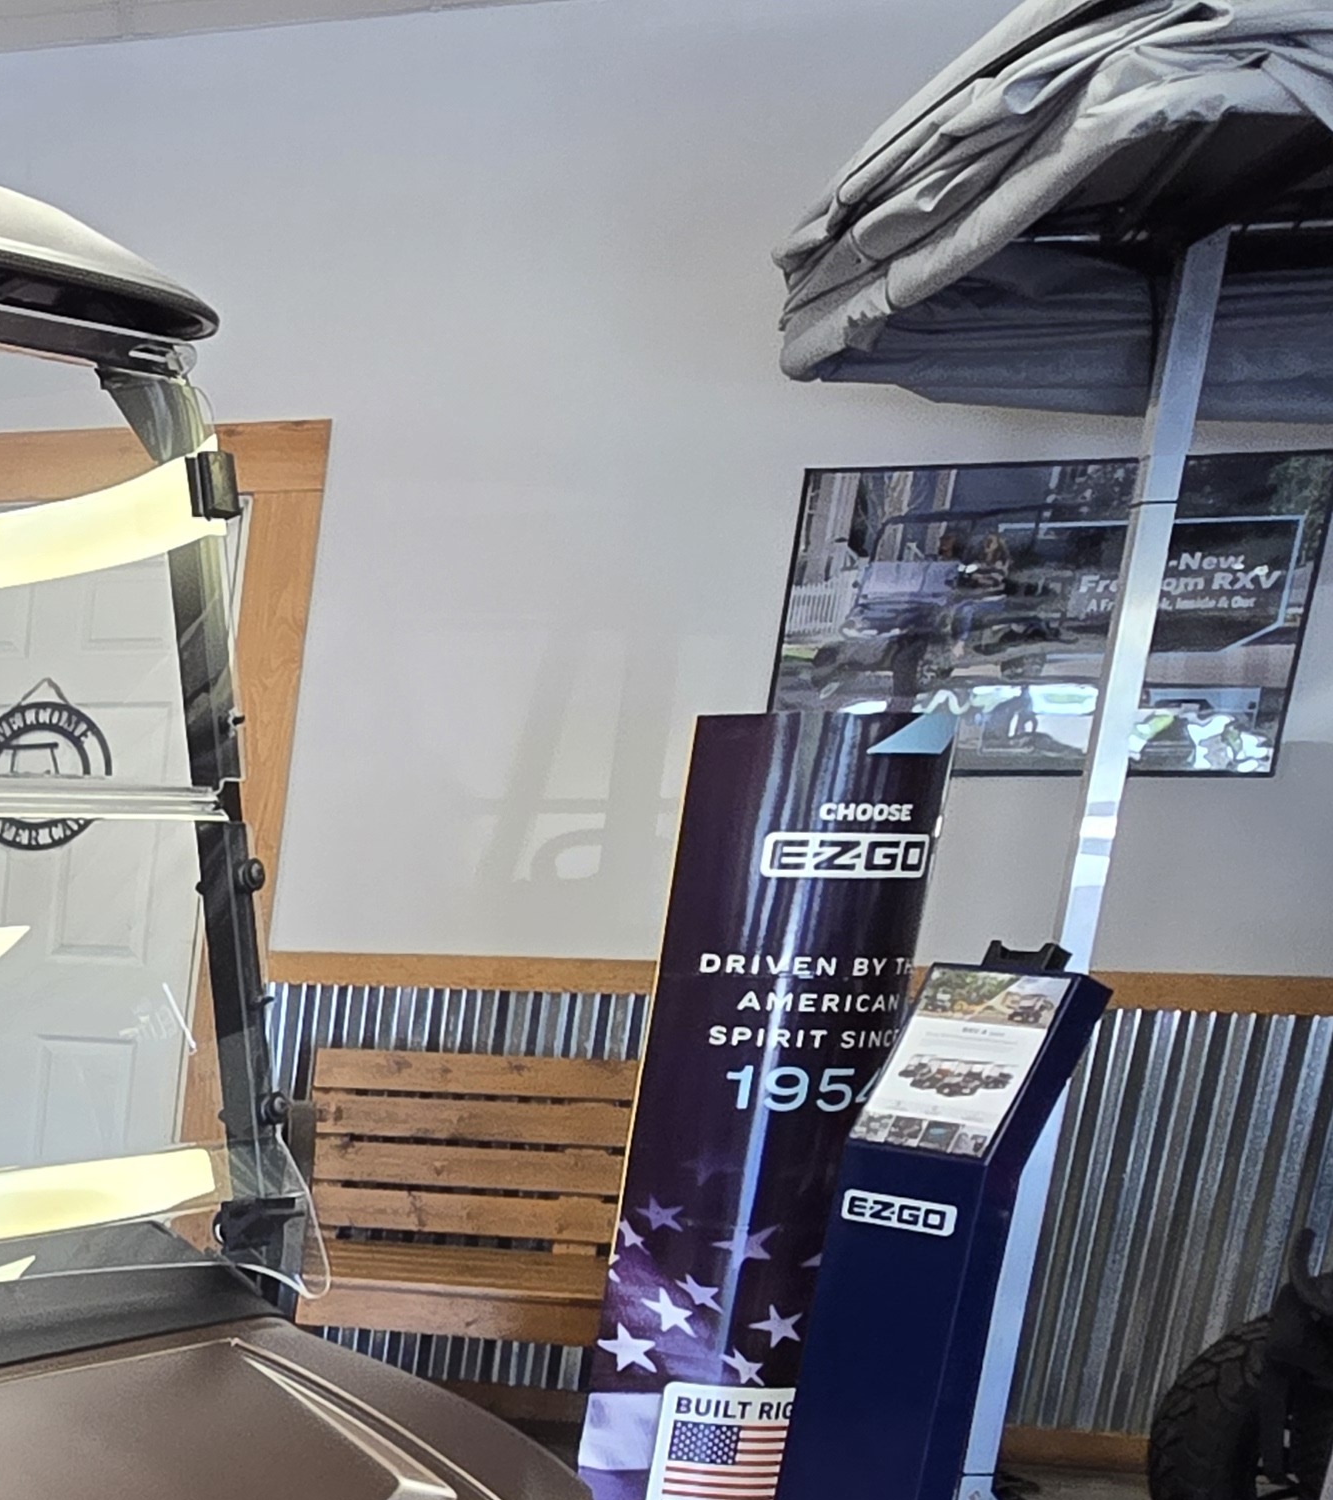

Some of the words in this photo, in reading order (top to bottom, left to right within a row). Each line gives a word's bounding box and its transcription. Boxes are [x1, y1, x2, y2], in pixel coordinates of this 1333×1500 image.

[1211, 570, 1282, 590] RXV
[819, 802, 914, 822] CHOOSE
[698, 953, 837, 977] DRIVEN
[852, 957, 888, 976] BY
[896, 957, 914, 975] TH
[736, 990, 900, 1013] AMERICAN
[707, 1025, 828, 1049] SPIRIT
[675, 1396, 752, 1420] BUILT
[758, 1400, 794, 1421] RIG
